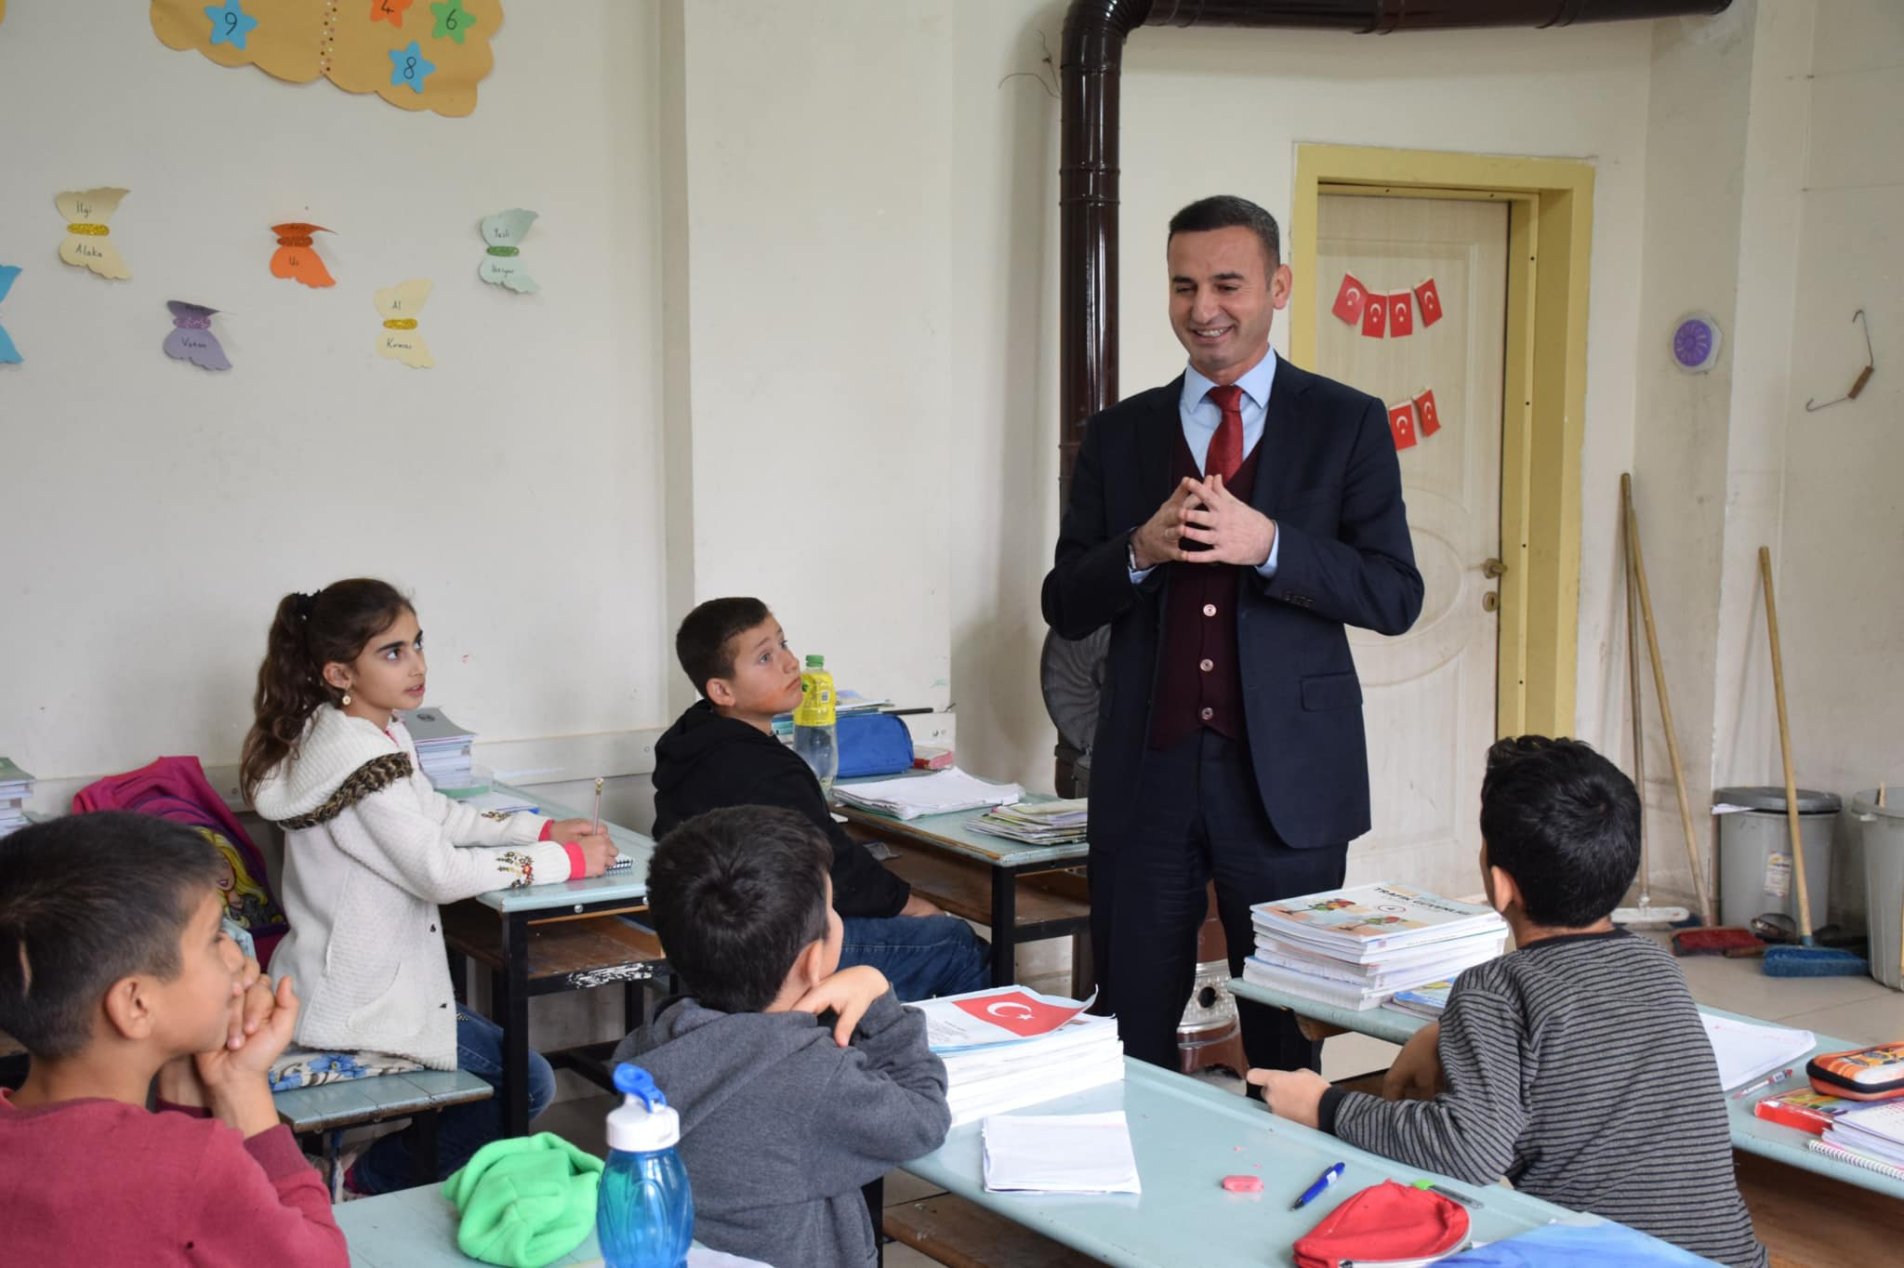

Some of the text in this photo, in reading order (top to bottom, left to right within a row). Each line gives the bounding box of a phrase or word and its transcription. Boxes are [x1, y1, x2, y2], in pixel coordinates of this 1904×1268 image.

[380, 0, 395, 15] 4
[446, 8, 458, 30] 6
[224, 12, 238, 36] 9
[403, 56, 417, 80] 8
